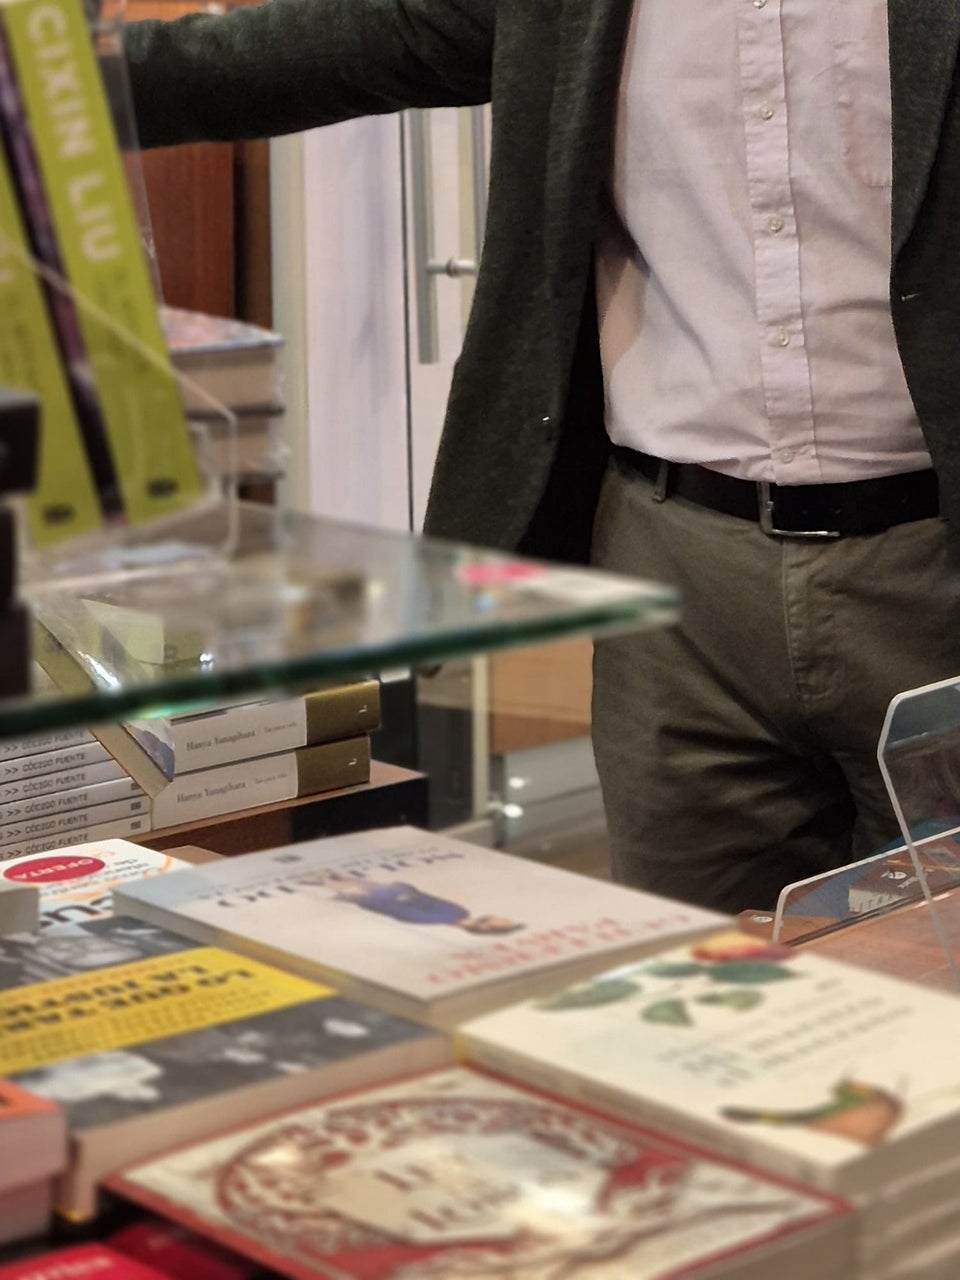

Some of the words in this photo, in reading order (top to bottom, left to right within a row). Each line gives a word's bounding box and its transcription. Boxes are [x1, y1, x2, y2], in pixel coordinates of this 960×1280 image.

[26, 3, 96, 161] CIXIN
[67, 171, 123, 263] LIU
[186, 740, 212, 751] Hanya
[214, 729, 256, 747] Yanagihara
[177, 792, 202, 803] Hanya
[204, 780, 246, 798] Yanagihara
[12, 858, 95, 880] OFERTA
